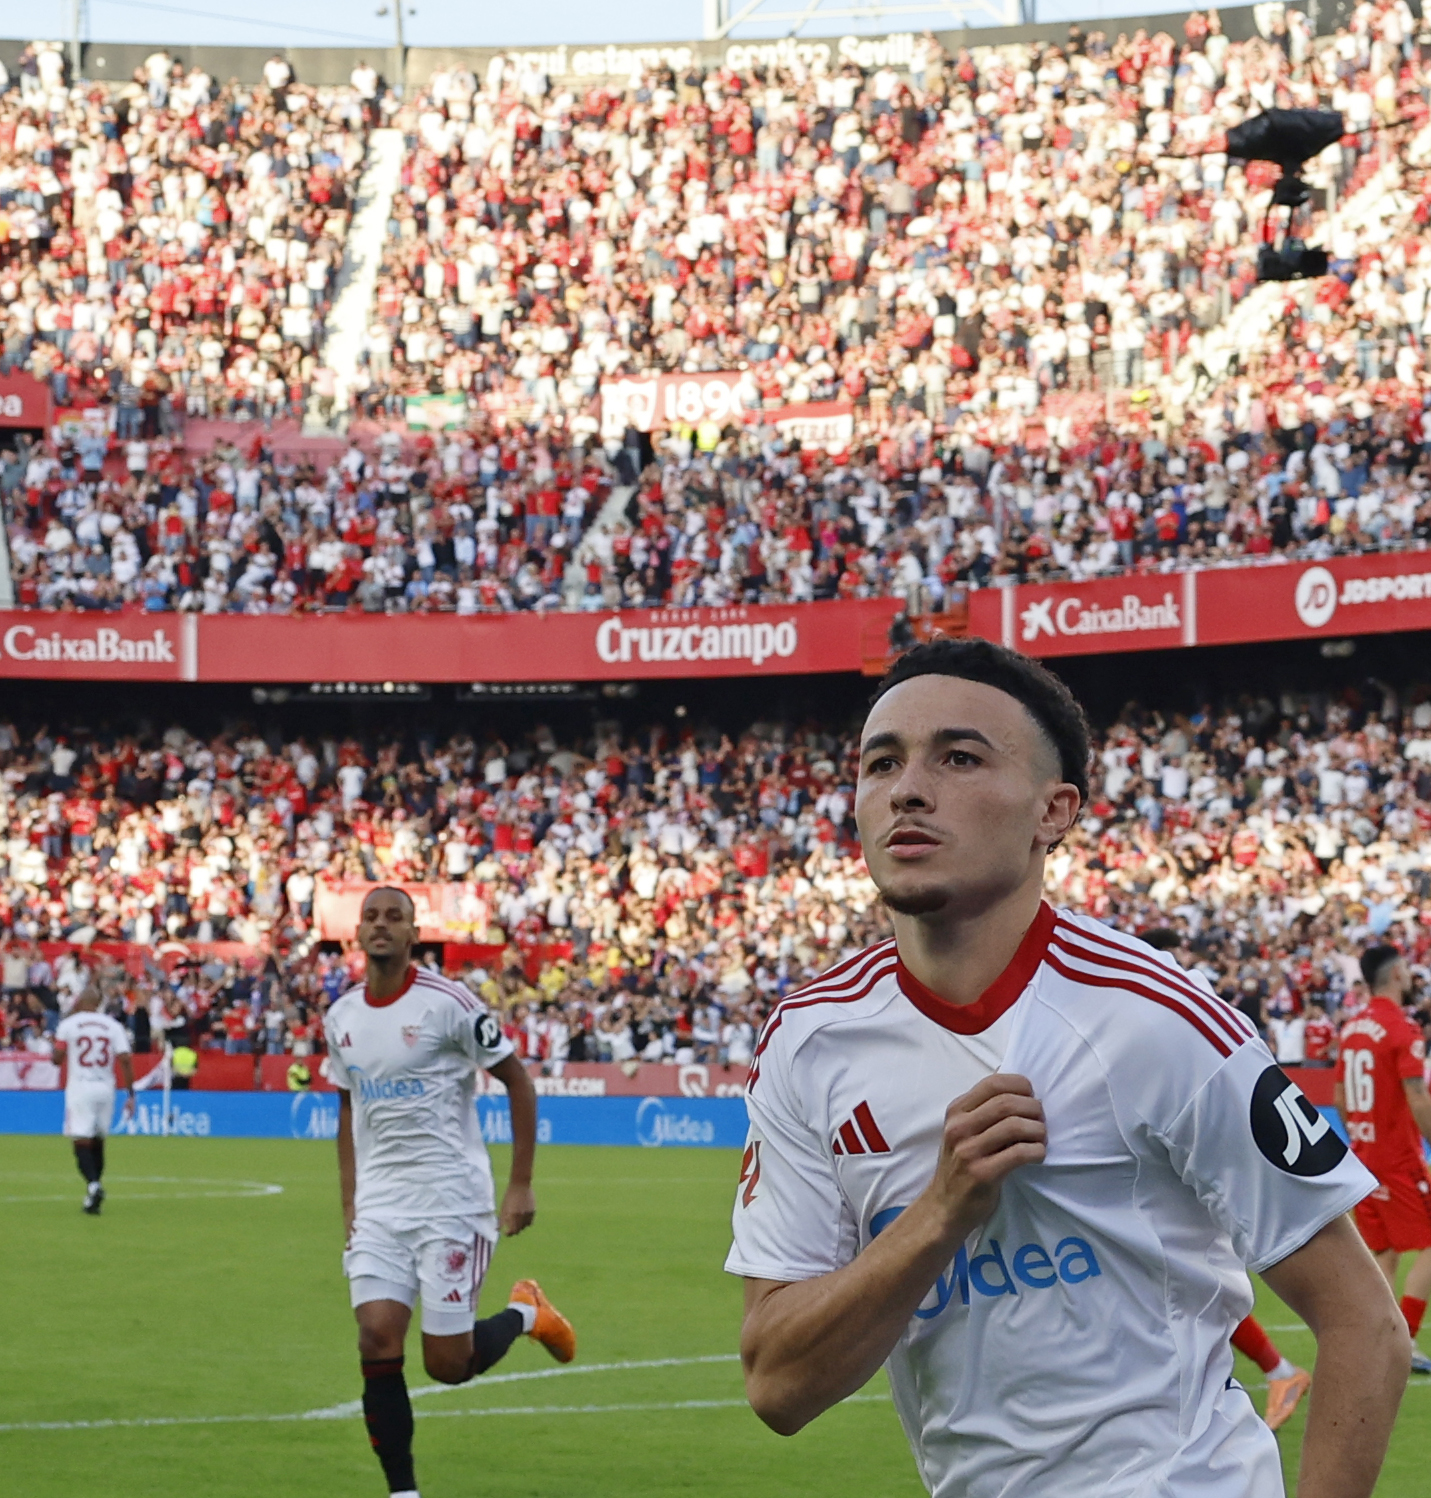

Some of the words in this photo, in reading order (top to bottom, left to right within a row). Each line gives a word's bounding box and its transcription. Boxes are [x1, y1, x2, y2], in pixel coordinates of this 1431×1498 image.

[1055, 591, 1182, 636] CaixaBank
[2, 624, 176, 663] CaixaBank
[595, 615, 798, 667] Cruzcampo
[77, 1036, 109, 1068] 23
[1342, 1048, 1375, 1113] 16
[649, 1113, 715, 1146] Midea
